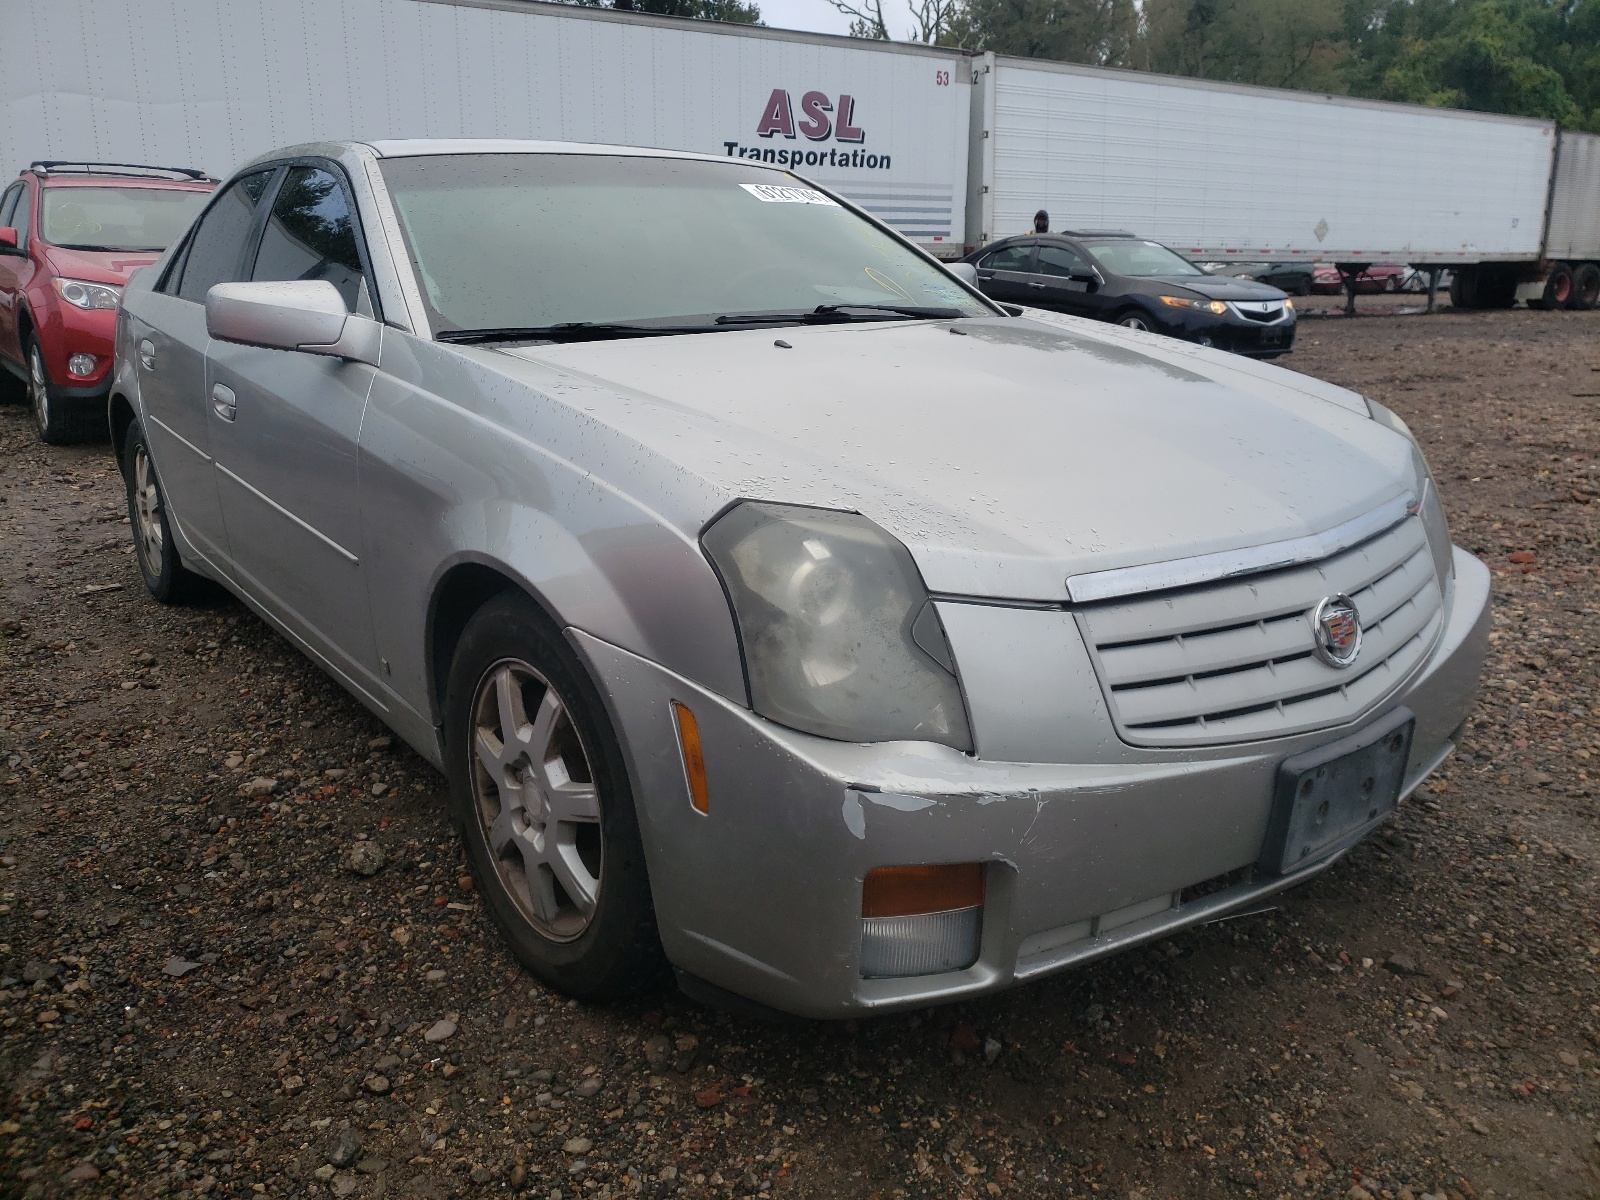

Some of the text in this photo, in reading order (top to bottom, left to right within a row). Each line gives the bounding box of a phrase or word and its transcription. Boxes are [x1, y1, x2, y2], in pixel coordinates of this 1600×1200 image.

[936, 70, 949, 86] 53
[756, 88, 865, 144] ASL
[724, 142, 891, 169] Transportation
